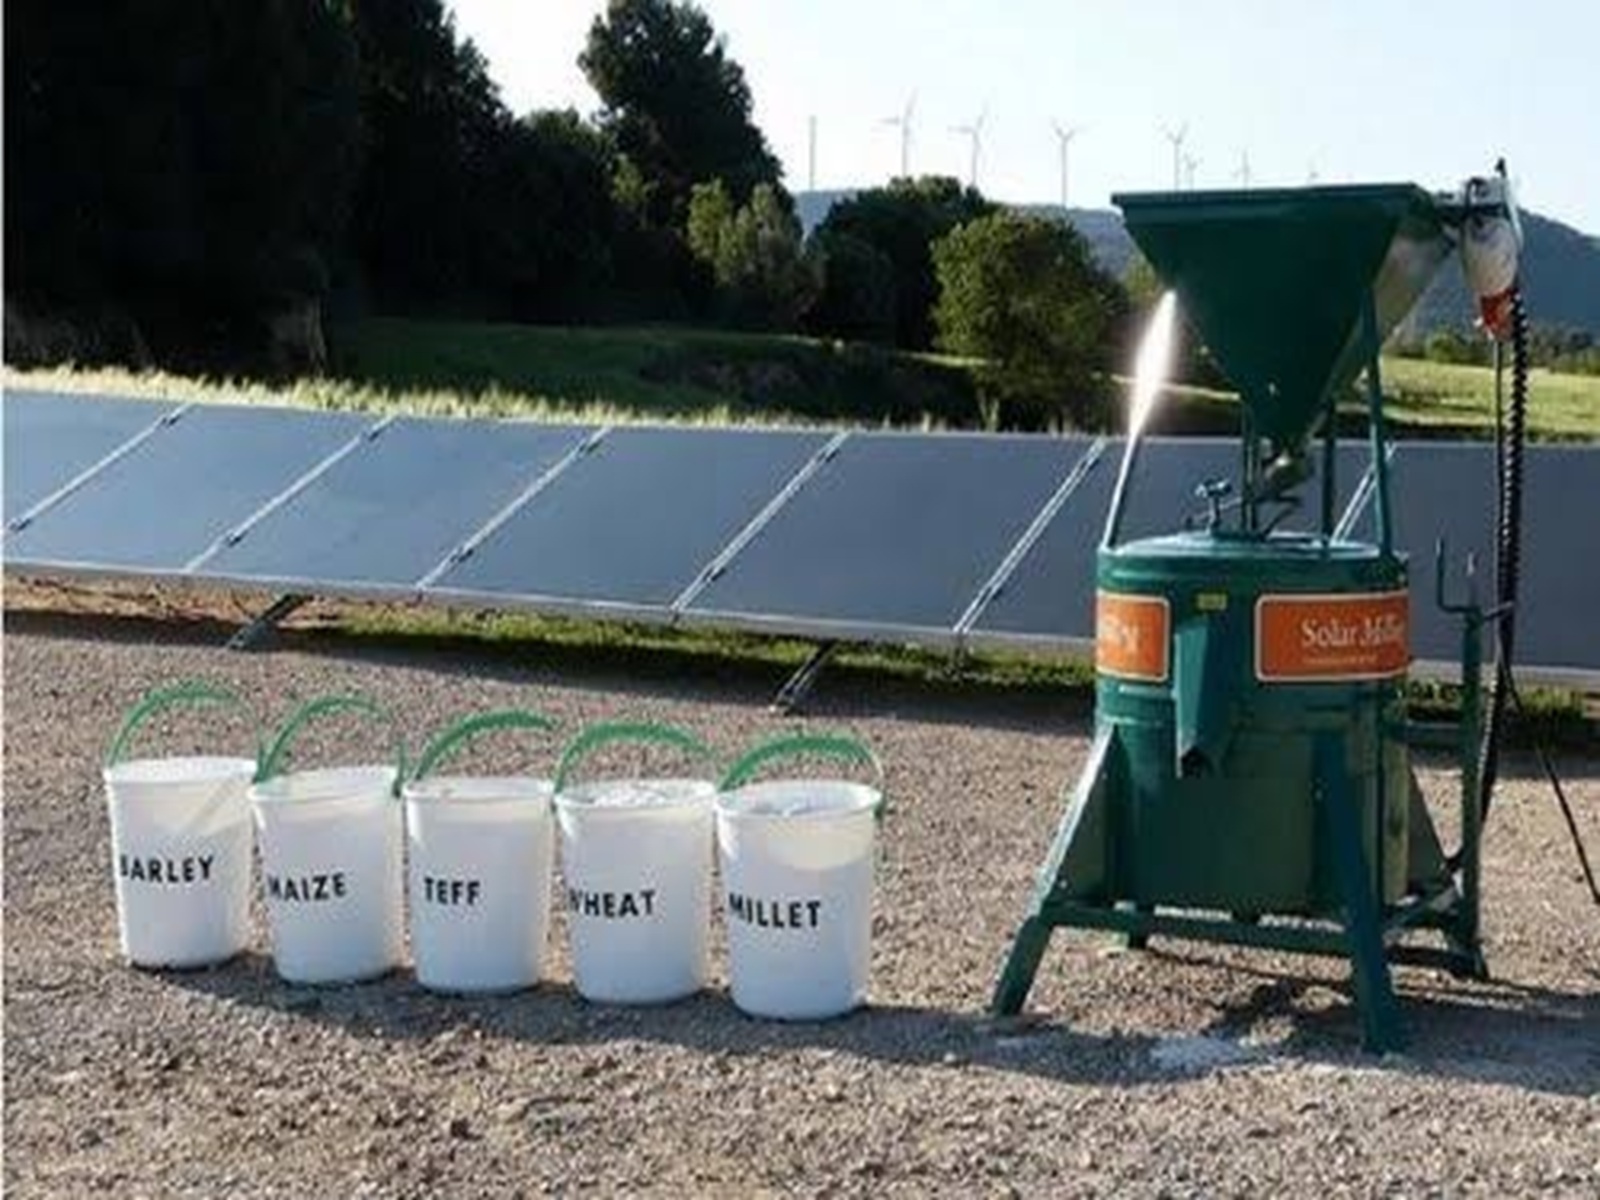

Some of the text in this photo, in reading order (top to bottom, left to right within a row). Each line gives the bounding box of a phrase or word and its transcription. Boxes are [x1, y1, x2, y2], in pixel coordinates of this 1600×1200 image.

[1301, 618, 1357, 648] Solar
[267, 873, 347, 900] MAIZE
[424, 877, 481, 905] TEFF
[729, 893, 821, 928] MILLET
